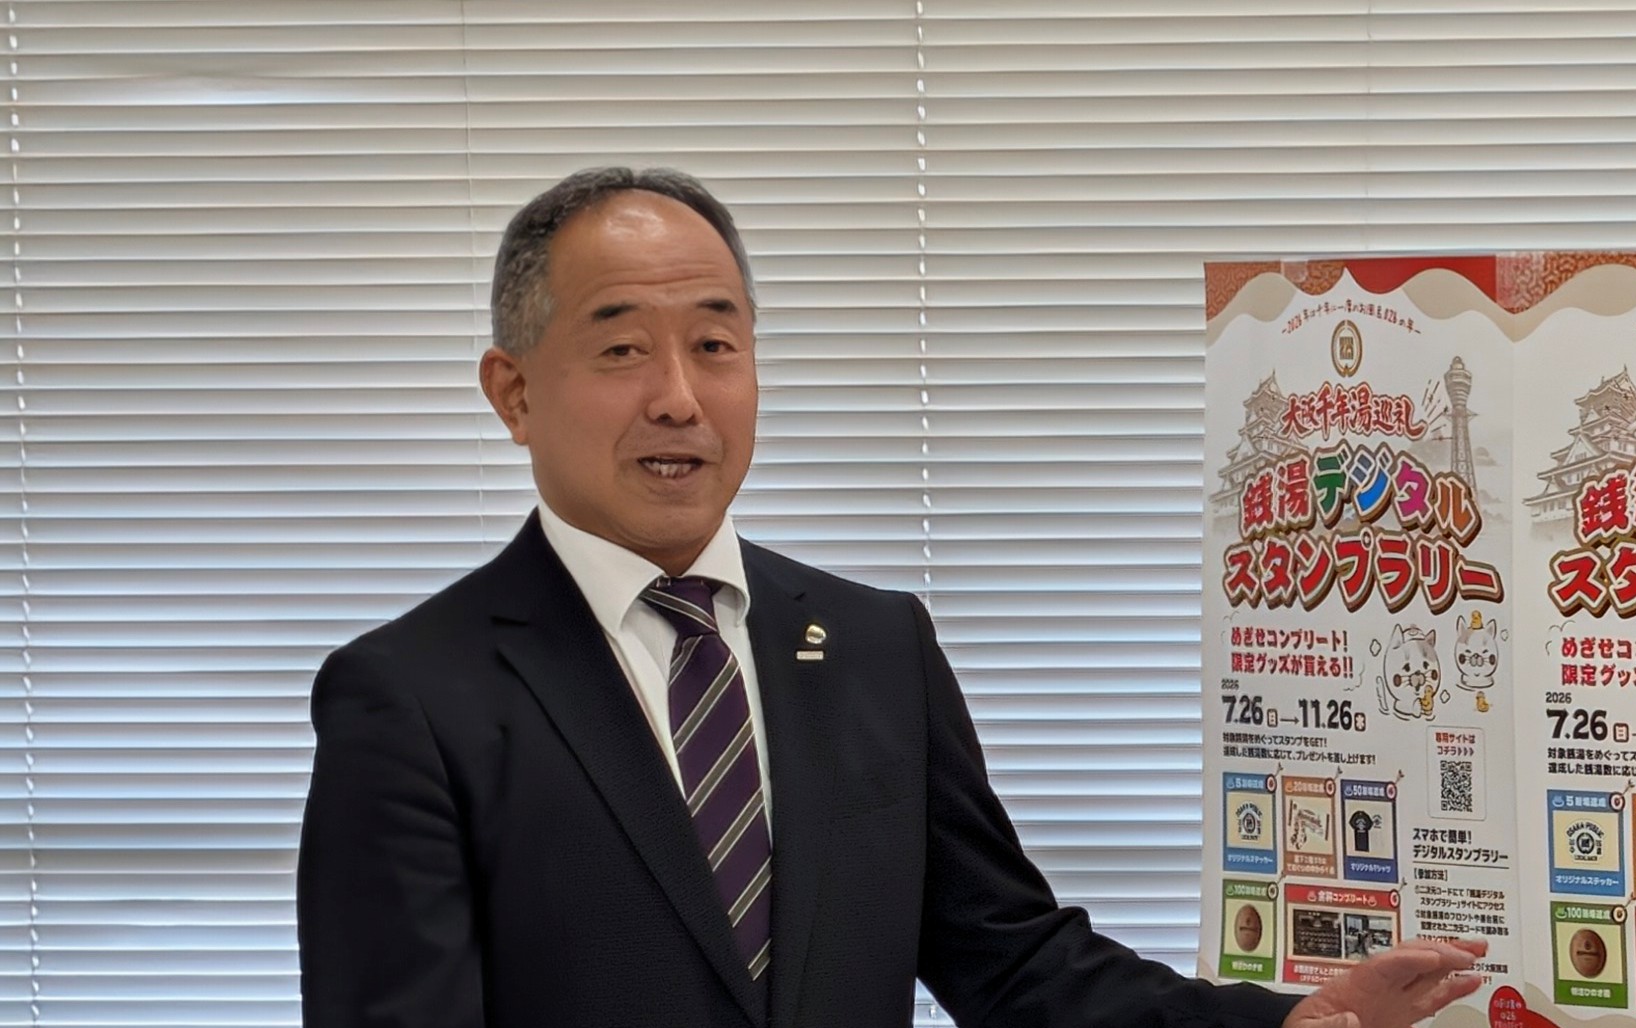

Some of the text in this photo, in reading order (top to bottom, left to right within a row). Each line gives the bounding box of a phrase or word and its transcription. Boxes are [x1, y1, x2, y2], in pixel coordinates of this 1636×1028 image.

[1281, 381, 1427, 441] 大阪千年湯巡礼
[1241, 440, 1481, 545] 銭湯デジタル
[1223, 526, 1504, 614] スタンプラリー
[1546, 692, 1571, 703] 2026
[1546, 708, 1607, 740] 7.26
[1412, 845, 1508, 863] デジタルスタンプラリー
[1555, 875, 1619, 886] オリジナルステッカー
